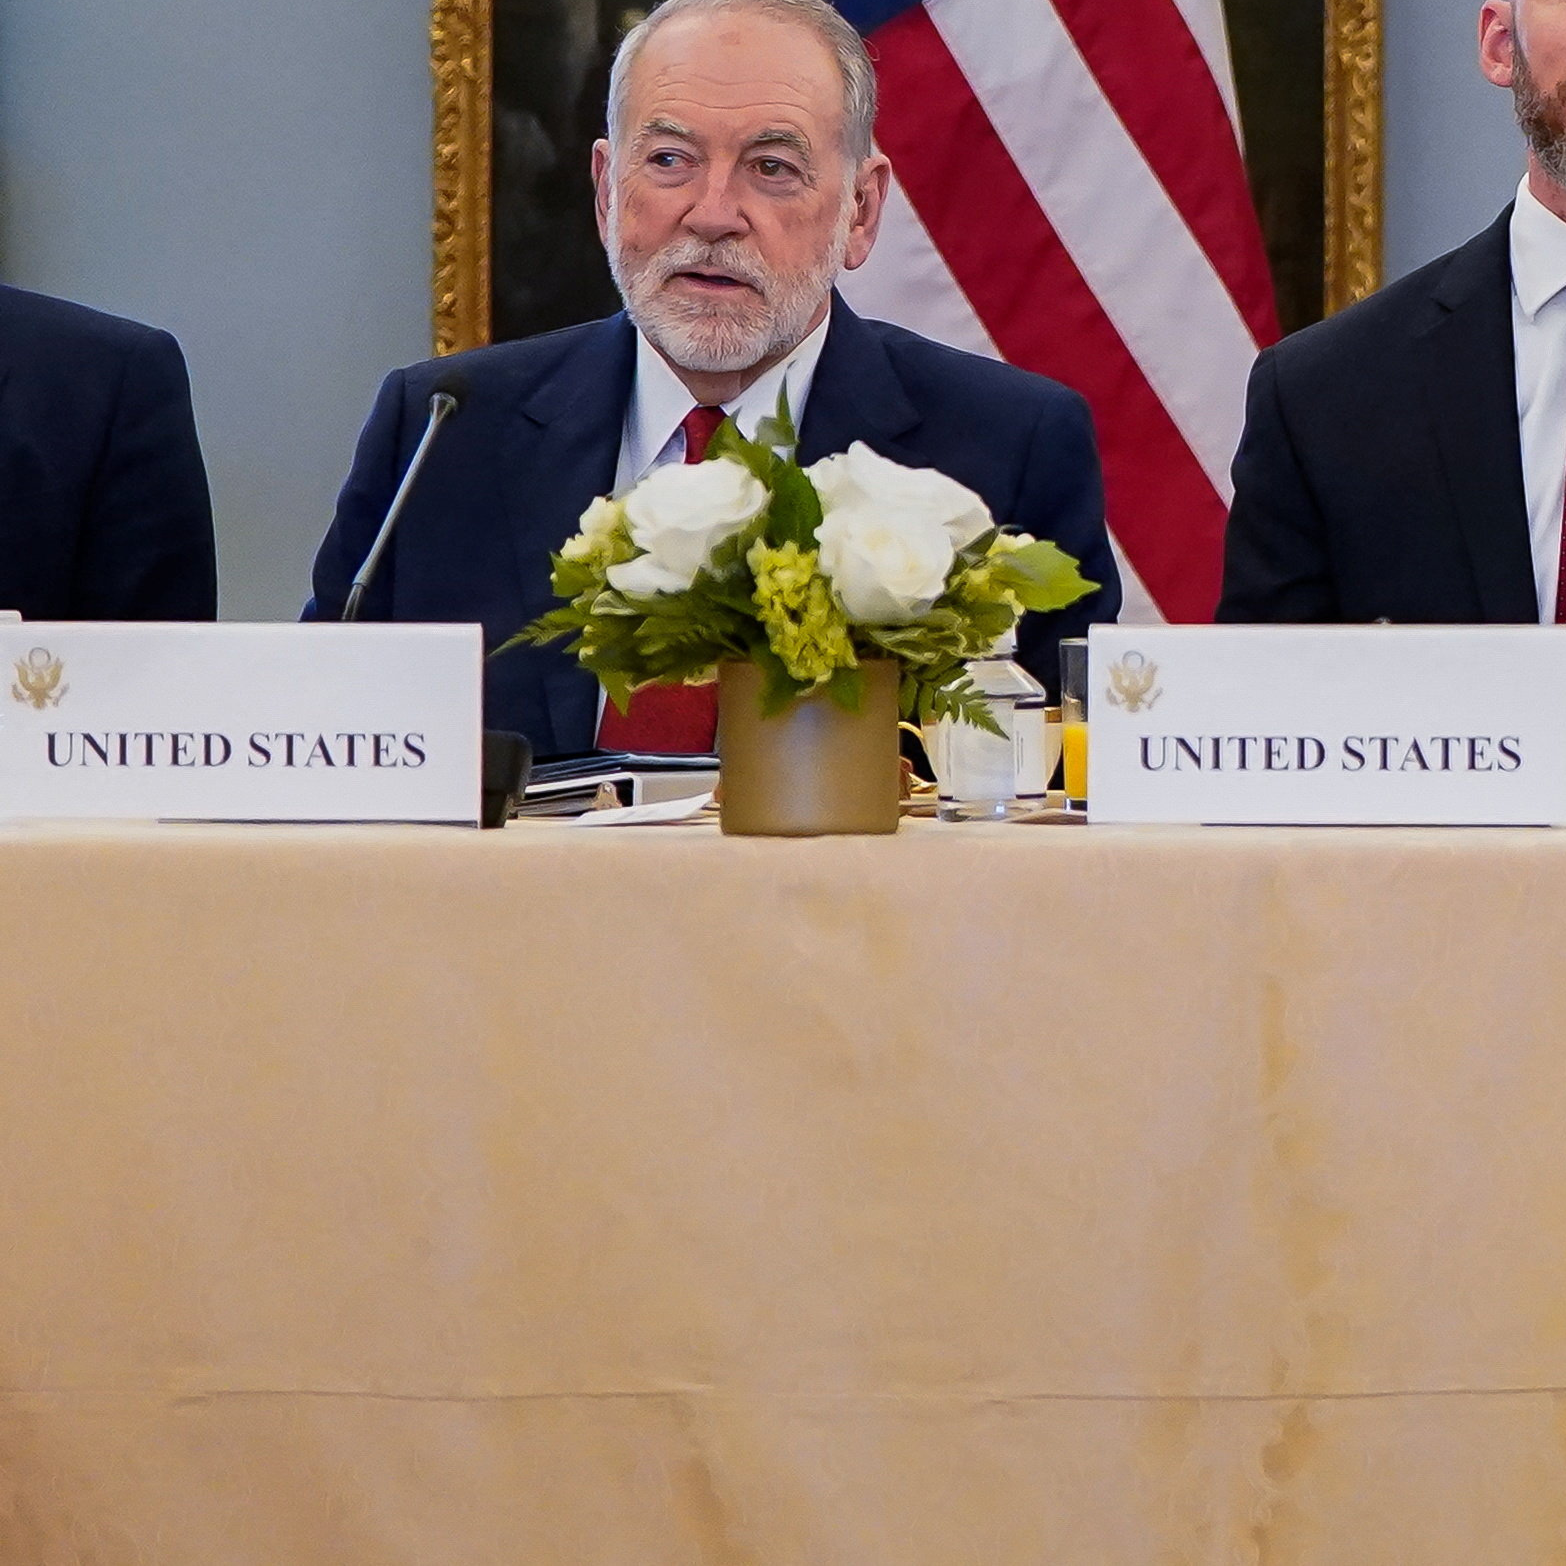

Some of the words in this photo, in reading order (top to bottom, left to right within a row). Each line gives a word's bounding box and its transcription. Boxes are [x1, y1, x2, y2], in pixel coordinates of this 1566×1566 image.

[46, 731, 231, 767] UNITED
[247, 731, 425, 767] STATES
[1139, 735, 1325, 771] UNITED
[1341, 735, 1521, 771] STATES
